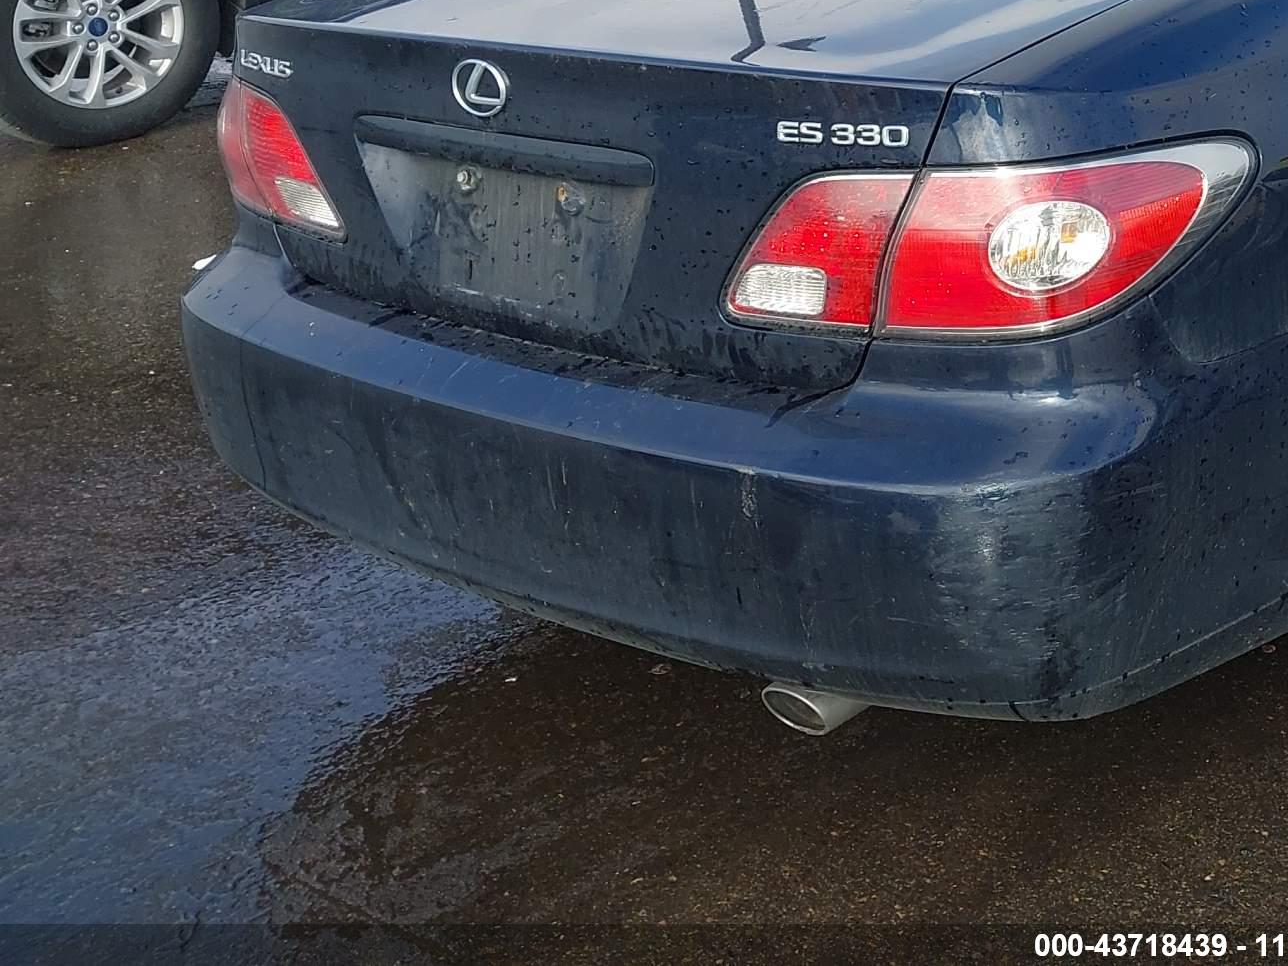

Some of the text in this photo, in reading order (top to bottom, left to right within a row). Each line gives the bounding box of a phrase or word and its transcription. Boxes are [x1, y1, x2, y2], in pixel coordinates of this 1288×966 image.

[241, 49, 293, 78] LEXUS
[777, 121, 909, 146] ES 330
